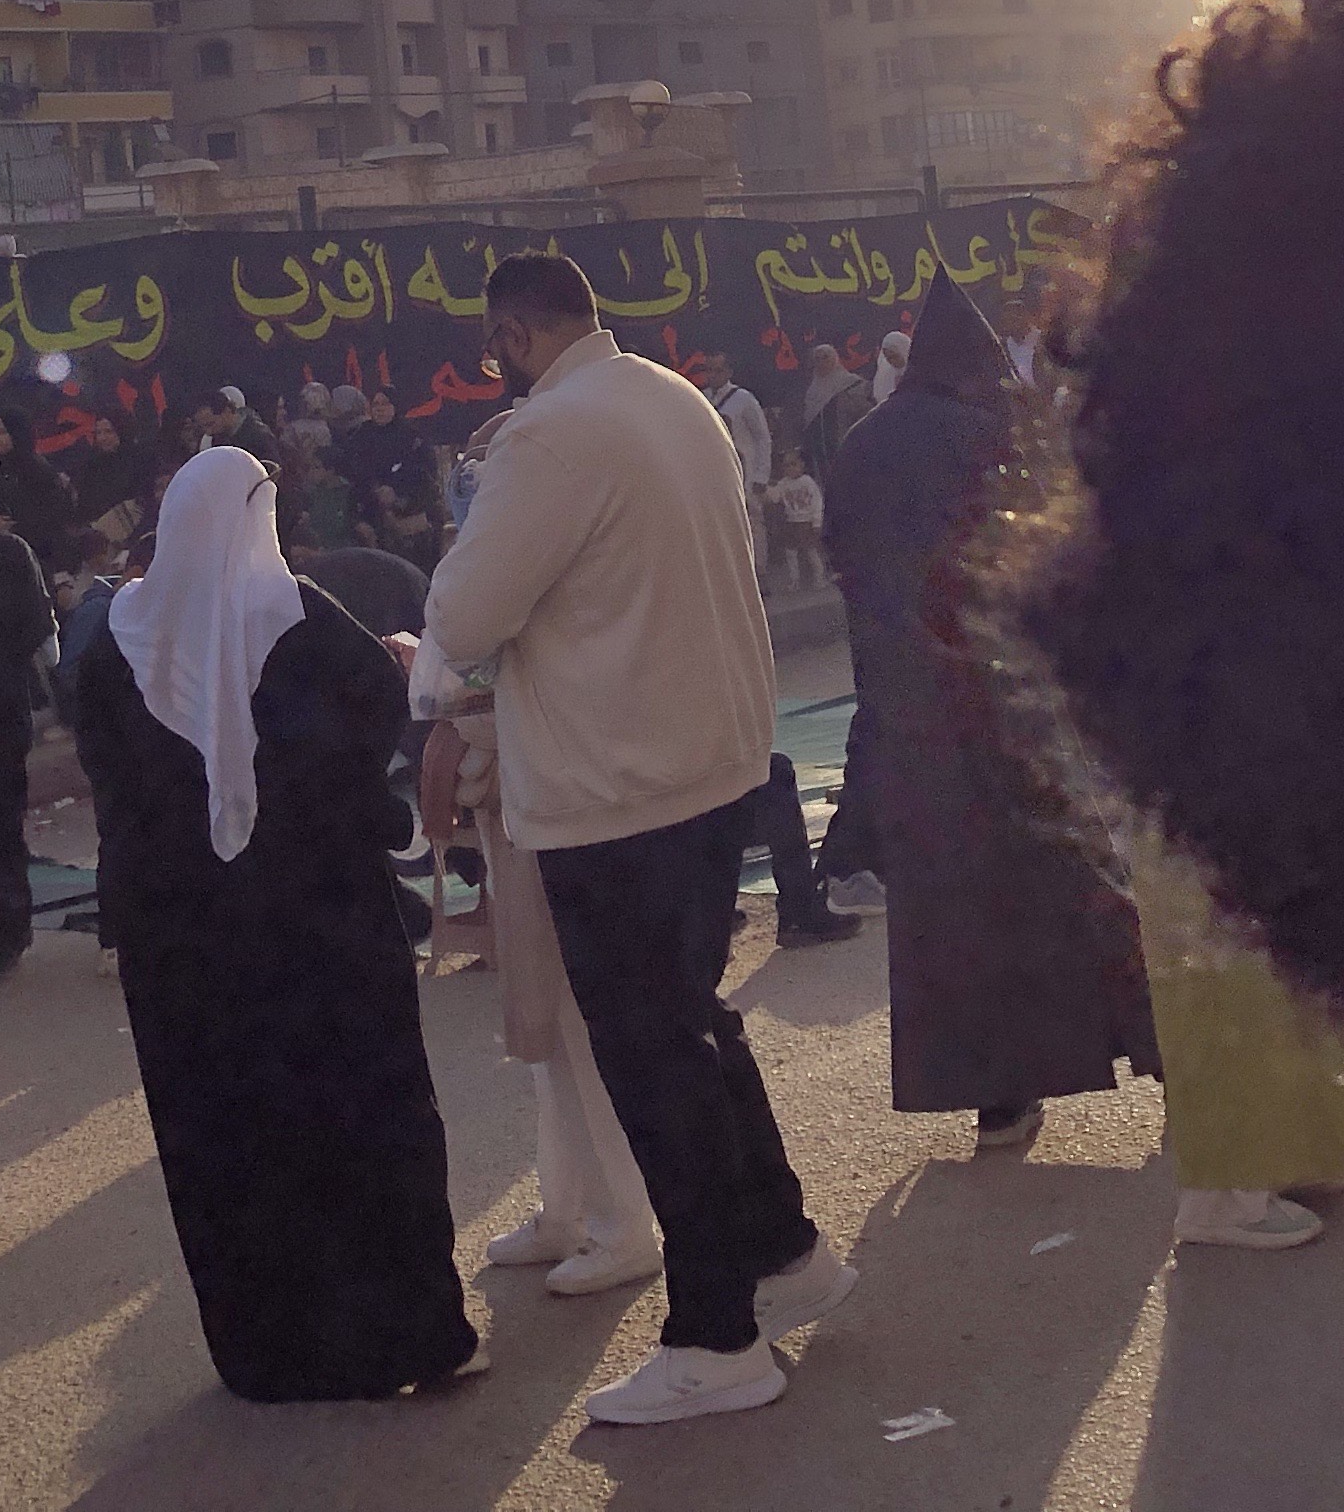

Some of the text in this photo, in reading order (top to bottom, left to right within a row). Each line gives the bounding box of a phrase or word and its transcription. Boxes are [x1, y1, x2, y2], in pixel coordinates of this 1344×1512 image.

[232, 238, 395, 343] أقرب
[593, 226, 709, 313] إلى
[897, 220, 997, 302] عام
